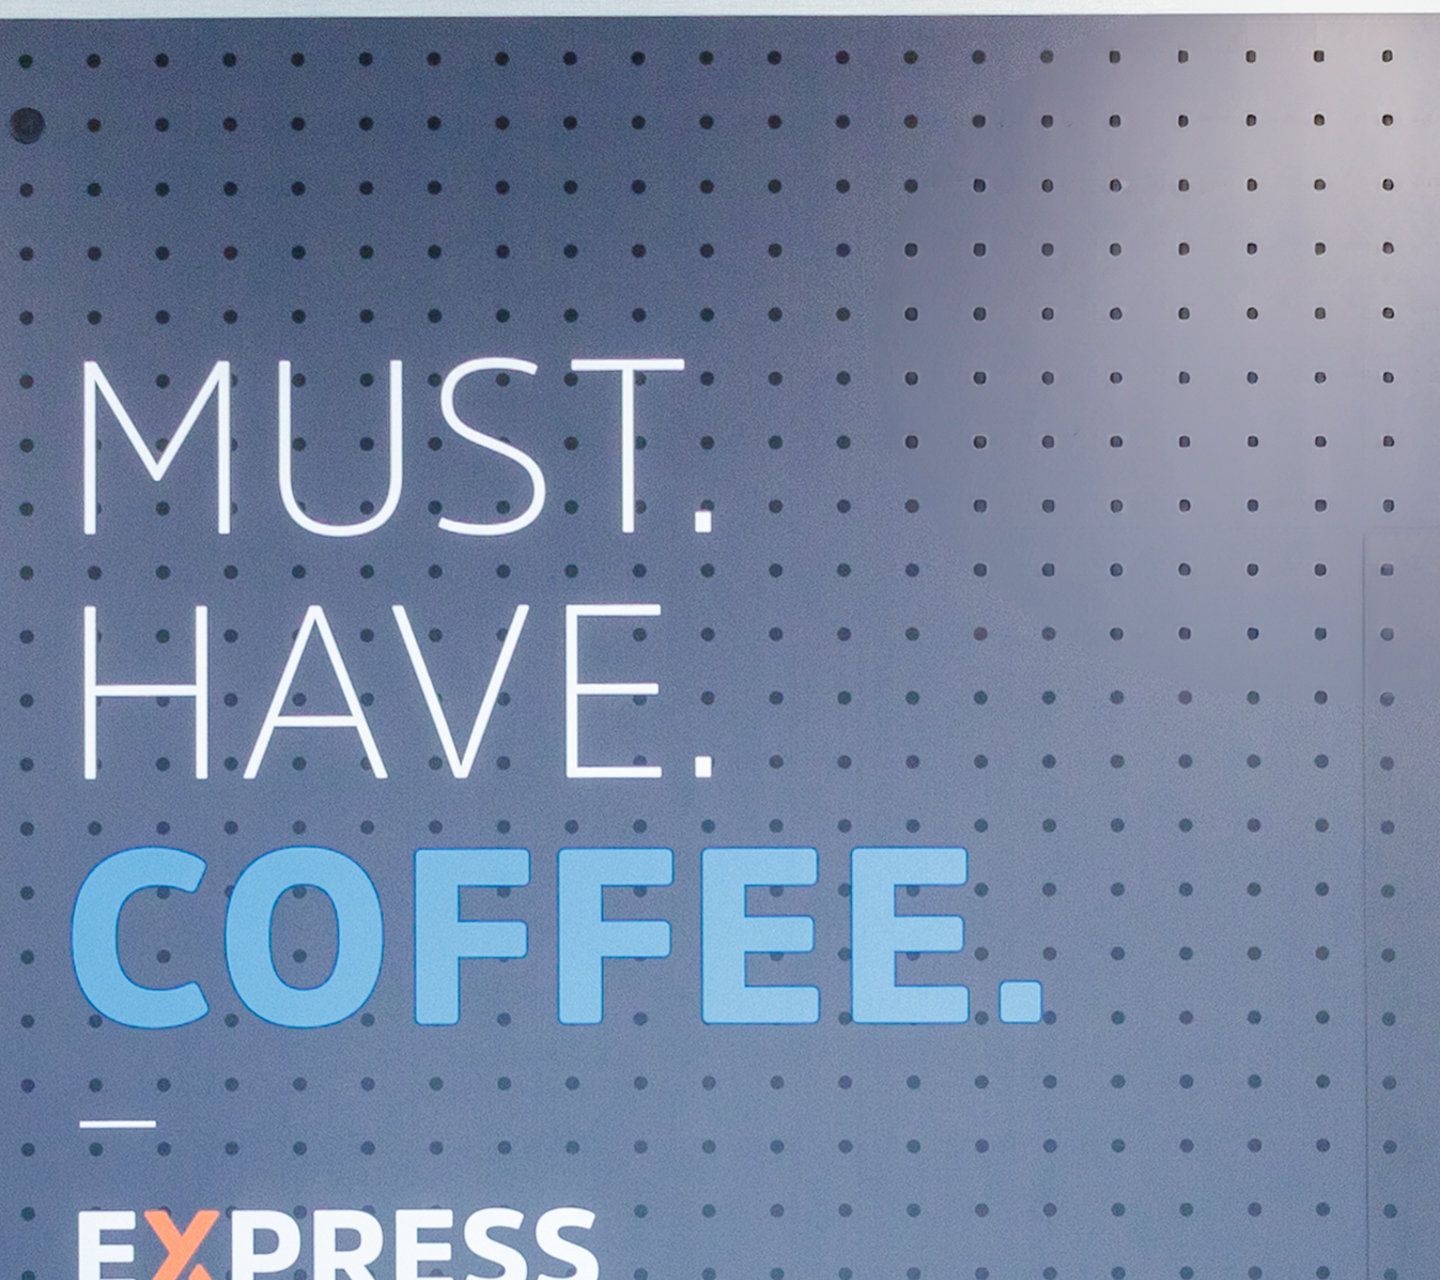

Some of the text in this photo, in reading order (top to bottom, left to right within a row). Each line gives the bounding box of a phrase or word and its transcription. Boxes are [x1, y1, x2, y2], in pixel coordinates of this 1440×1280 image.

[83, 356, 714, 537] MUST.
[83, 603, 714, 780] HAVE.
[70, 843, 1043, 1029] COFFEE.
